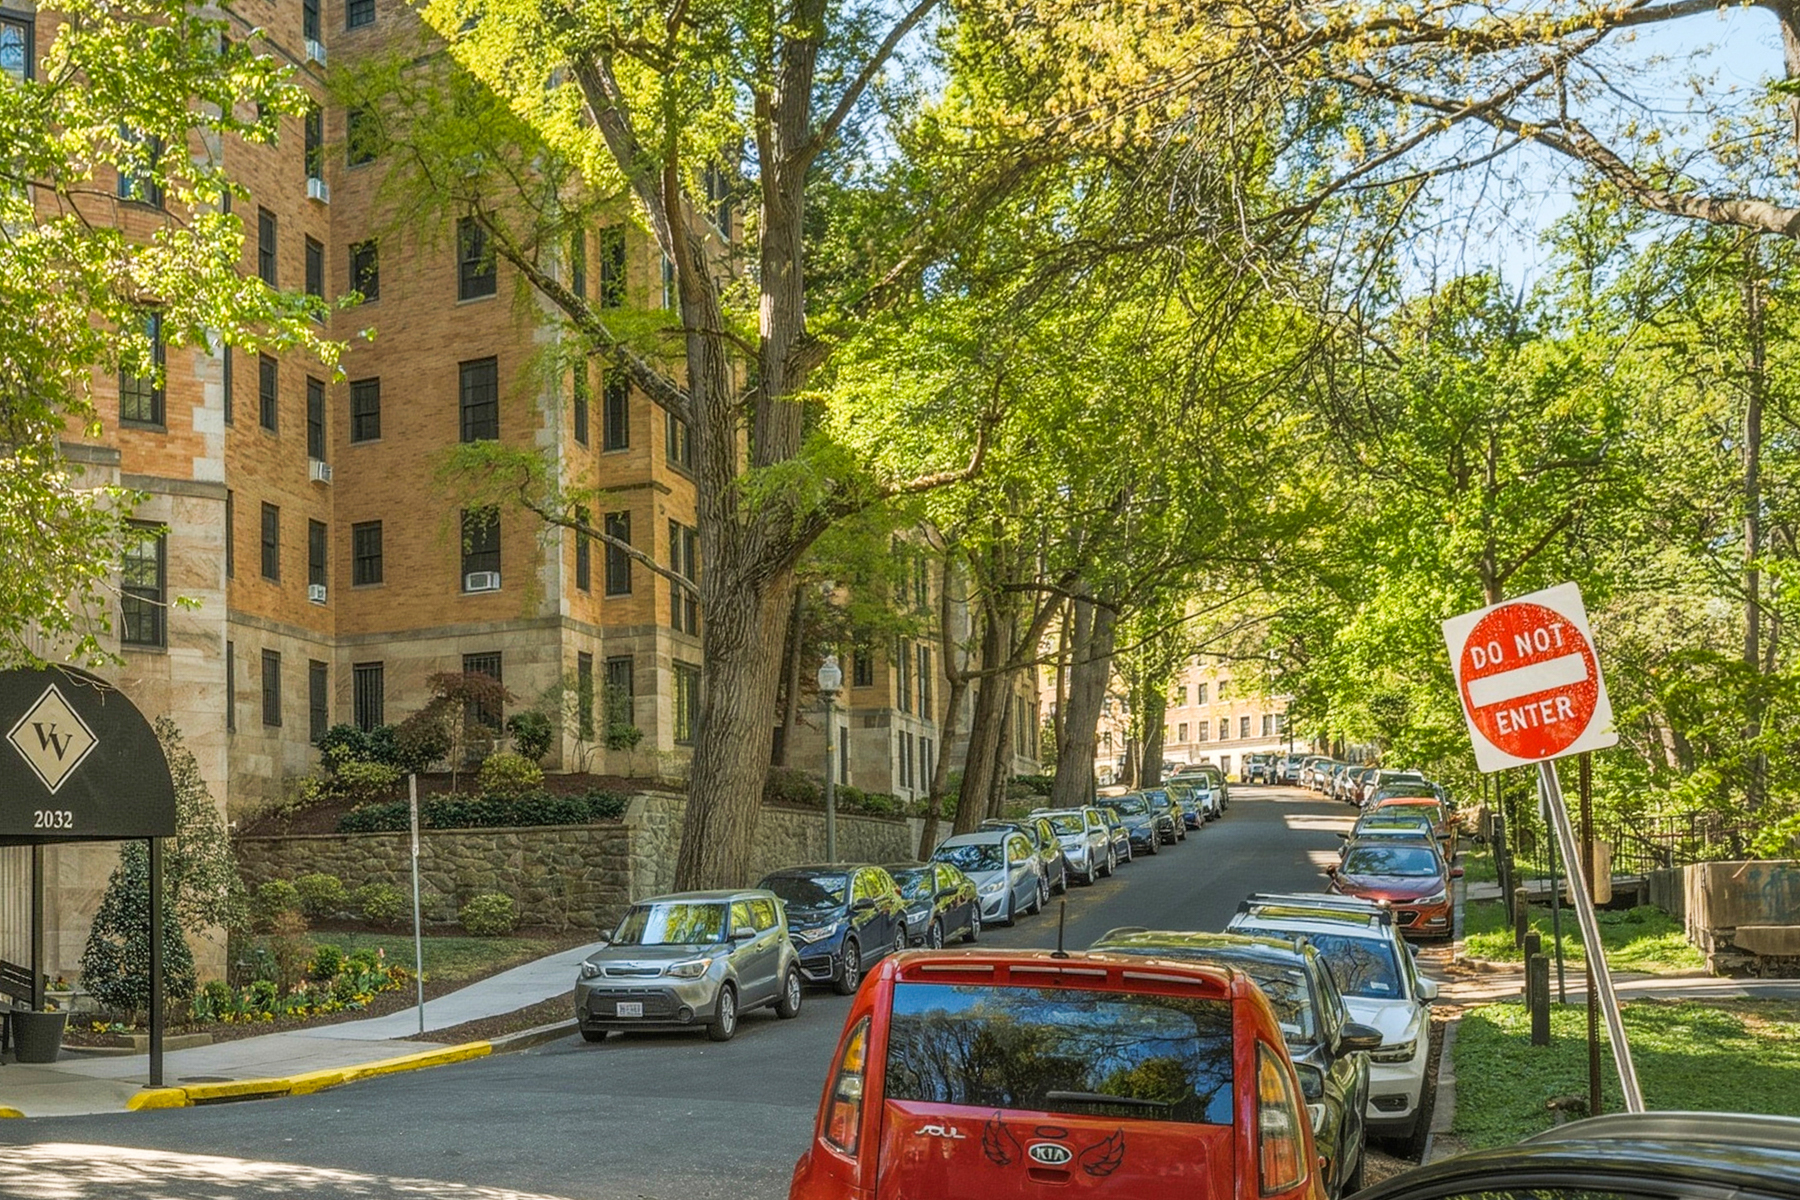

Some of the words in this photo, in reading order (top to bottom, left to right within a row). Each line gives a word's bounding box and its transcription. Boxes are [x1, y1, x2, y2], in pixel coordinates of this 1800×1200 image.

[1470, 641, 1503, 670] DO
[1514, 623, 1565, 658] NOT
[1495, 696, 1575, 735] ENTER
[32, 722, 73, 761] VV
[34, 810, 73, 828] 2032
[914, 1124, 967, 1139] SOUL
[1035, 1147, 1066, 1161] KIA
